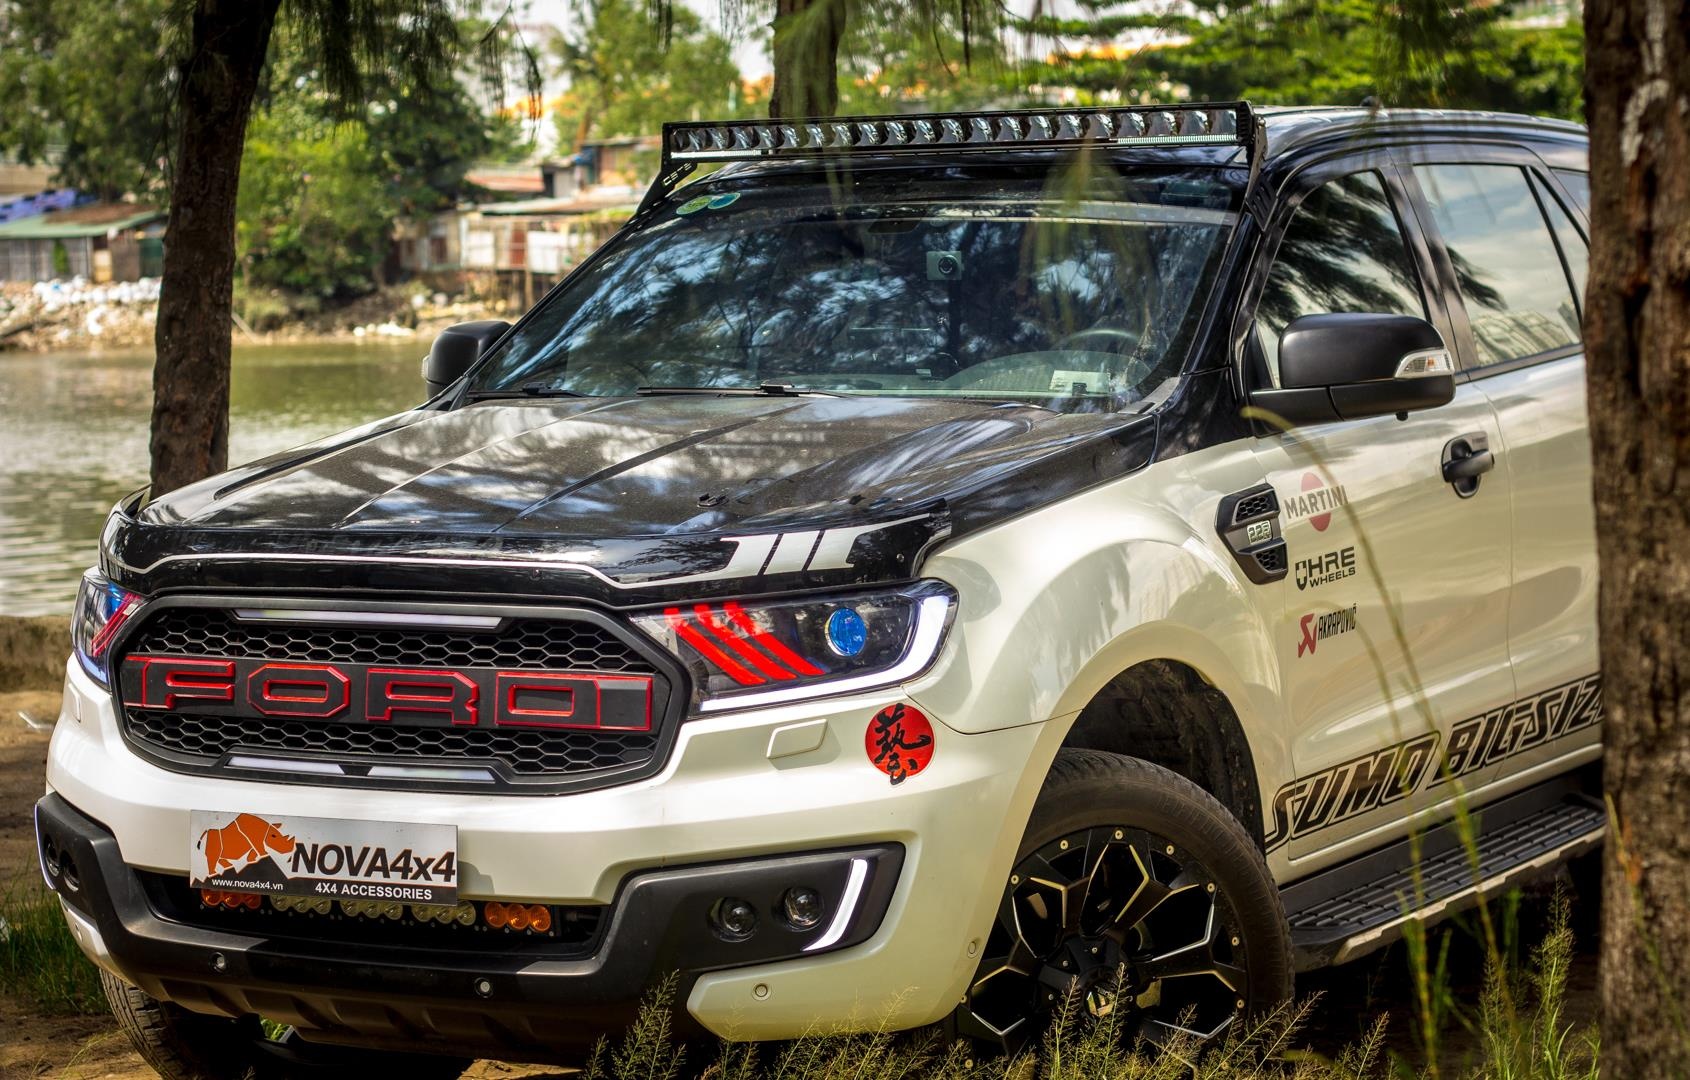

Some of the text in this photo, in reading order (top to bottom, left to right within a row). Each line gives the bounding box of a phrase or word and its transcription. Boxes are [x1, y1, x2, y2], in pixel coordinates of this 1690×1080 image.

[1284, 485, 1349, 519] MARTINI
[1307, 546, 1355, 578] HRE
[1309, 566, 1356, 588] WHEELS
[124, 656, 653, 731] FORD
[1265, 674, 1605, 854] SUMO BIGSIZ
[291, 842, 456, 882] NOVA4x4
[212, 878, 284, 891] www.nova4x4.vn
[315, 882, 433, 901] 4X4 ACCESSORIES
